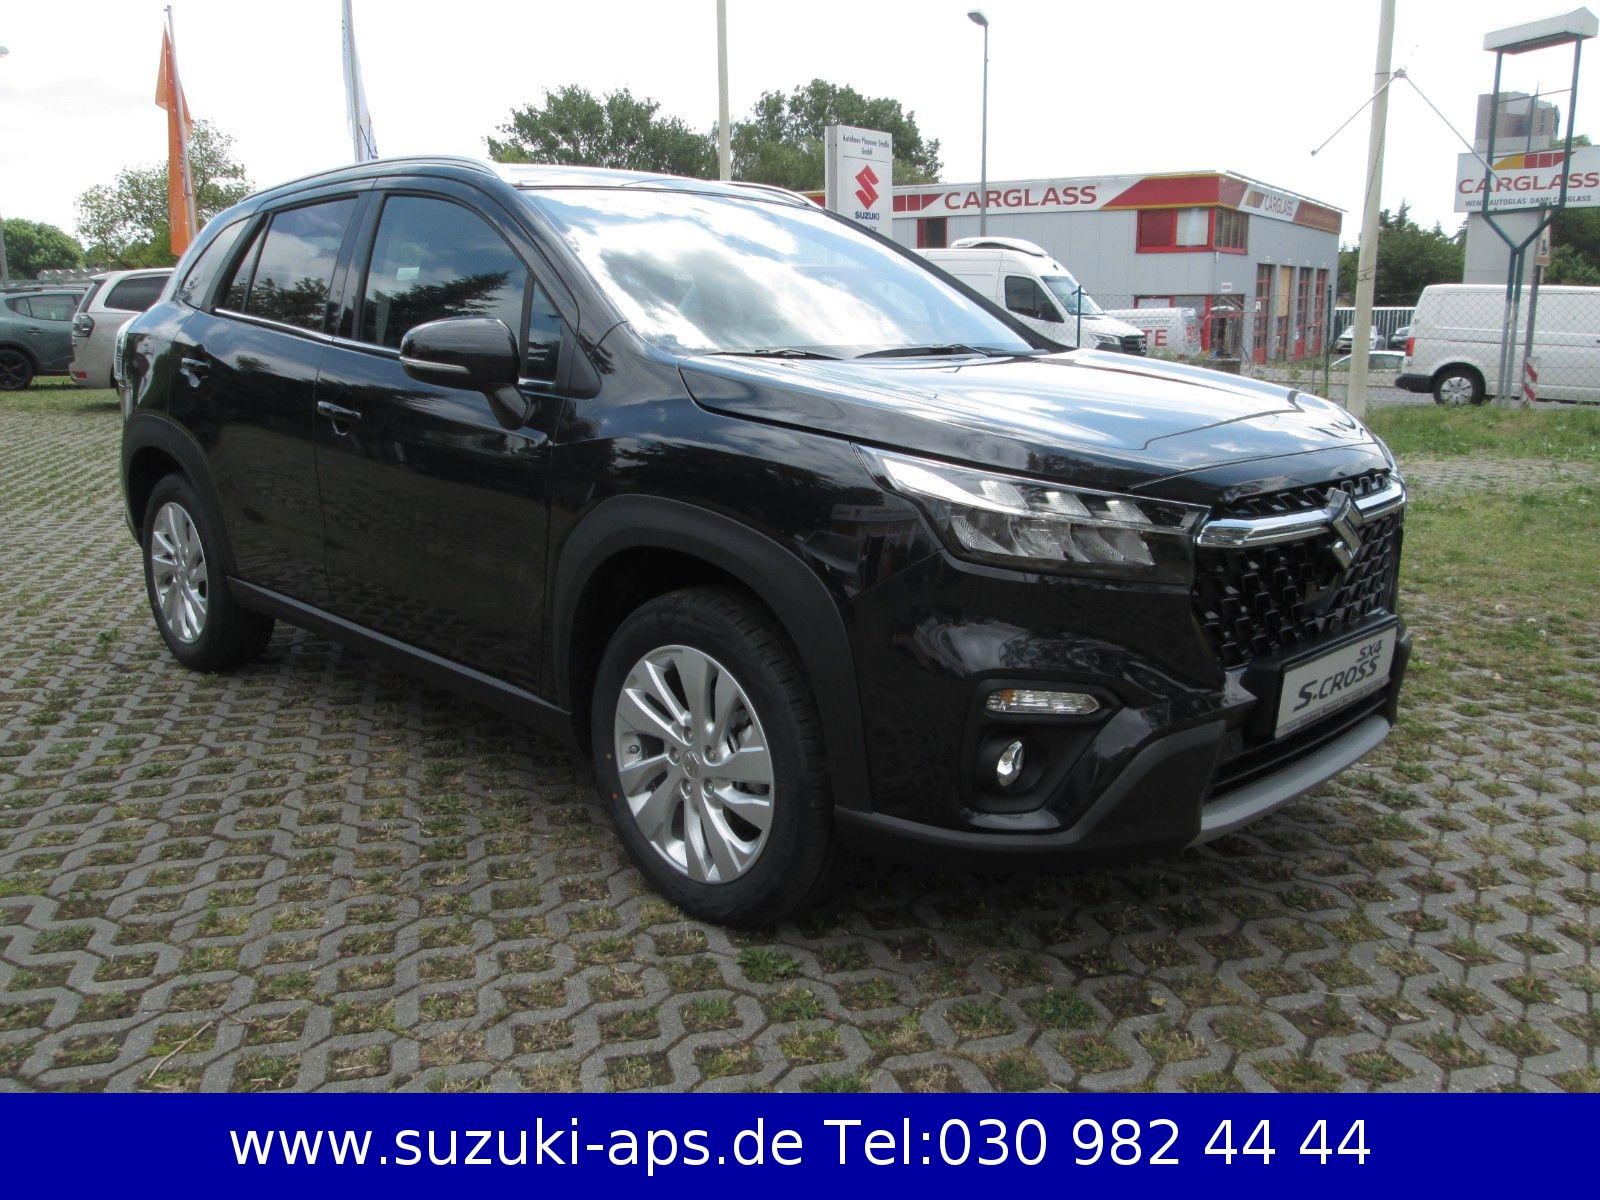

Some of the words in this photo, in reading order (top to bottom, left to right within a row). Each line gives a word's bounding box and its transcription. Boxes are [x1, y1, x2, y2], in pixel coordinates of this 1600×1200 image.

[1458, 172, 1600, 194] CARGLASS
[944, 185, 1097, 210] CARGLASS
[1264, 194, 1294, 217] CARGLASS
[1465, 199, 1484, 207] WEN
[1489, 197, 1527, 206] AUTOGLAS
[854, 211, 880, 220] SUZUKI
[1359, 639, 1383, 659] SX4
